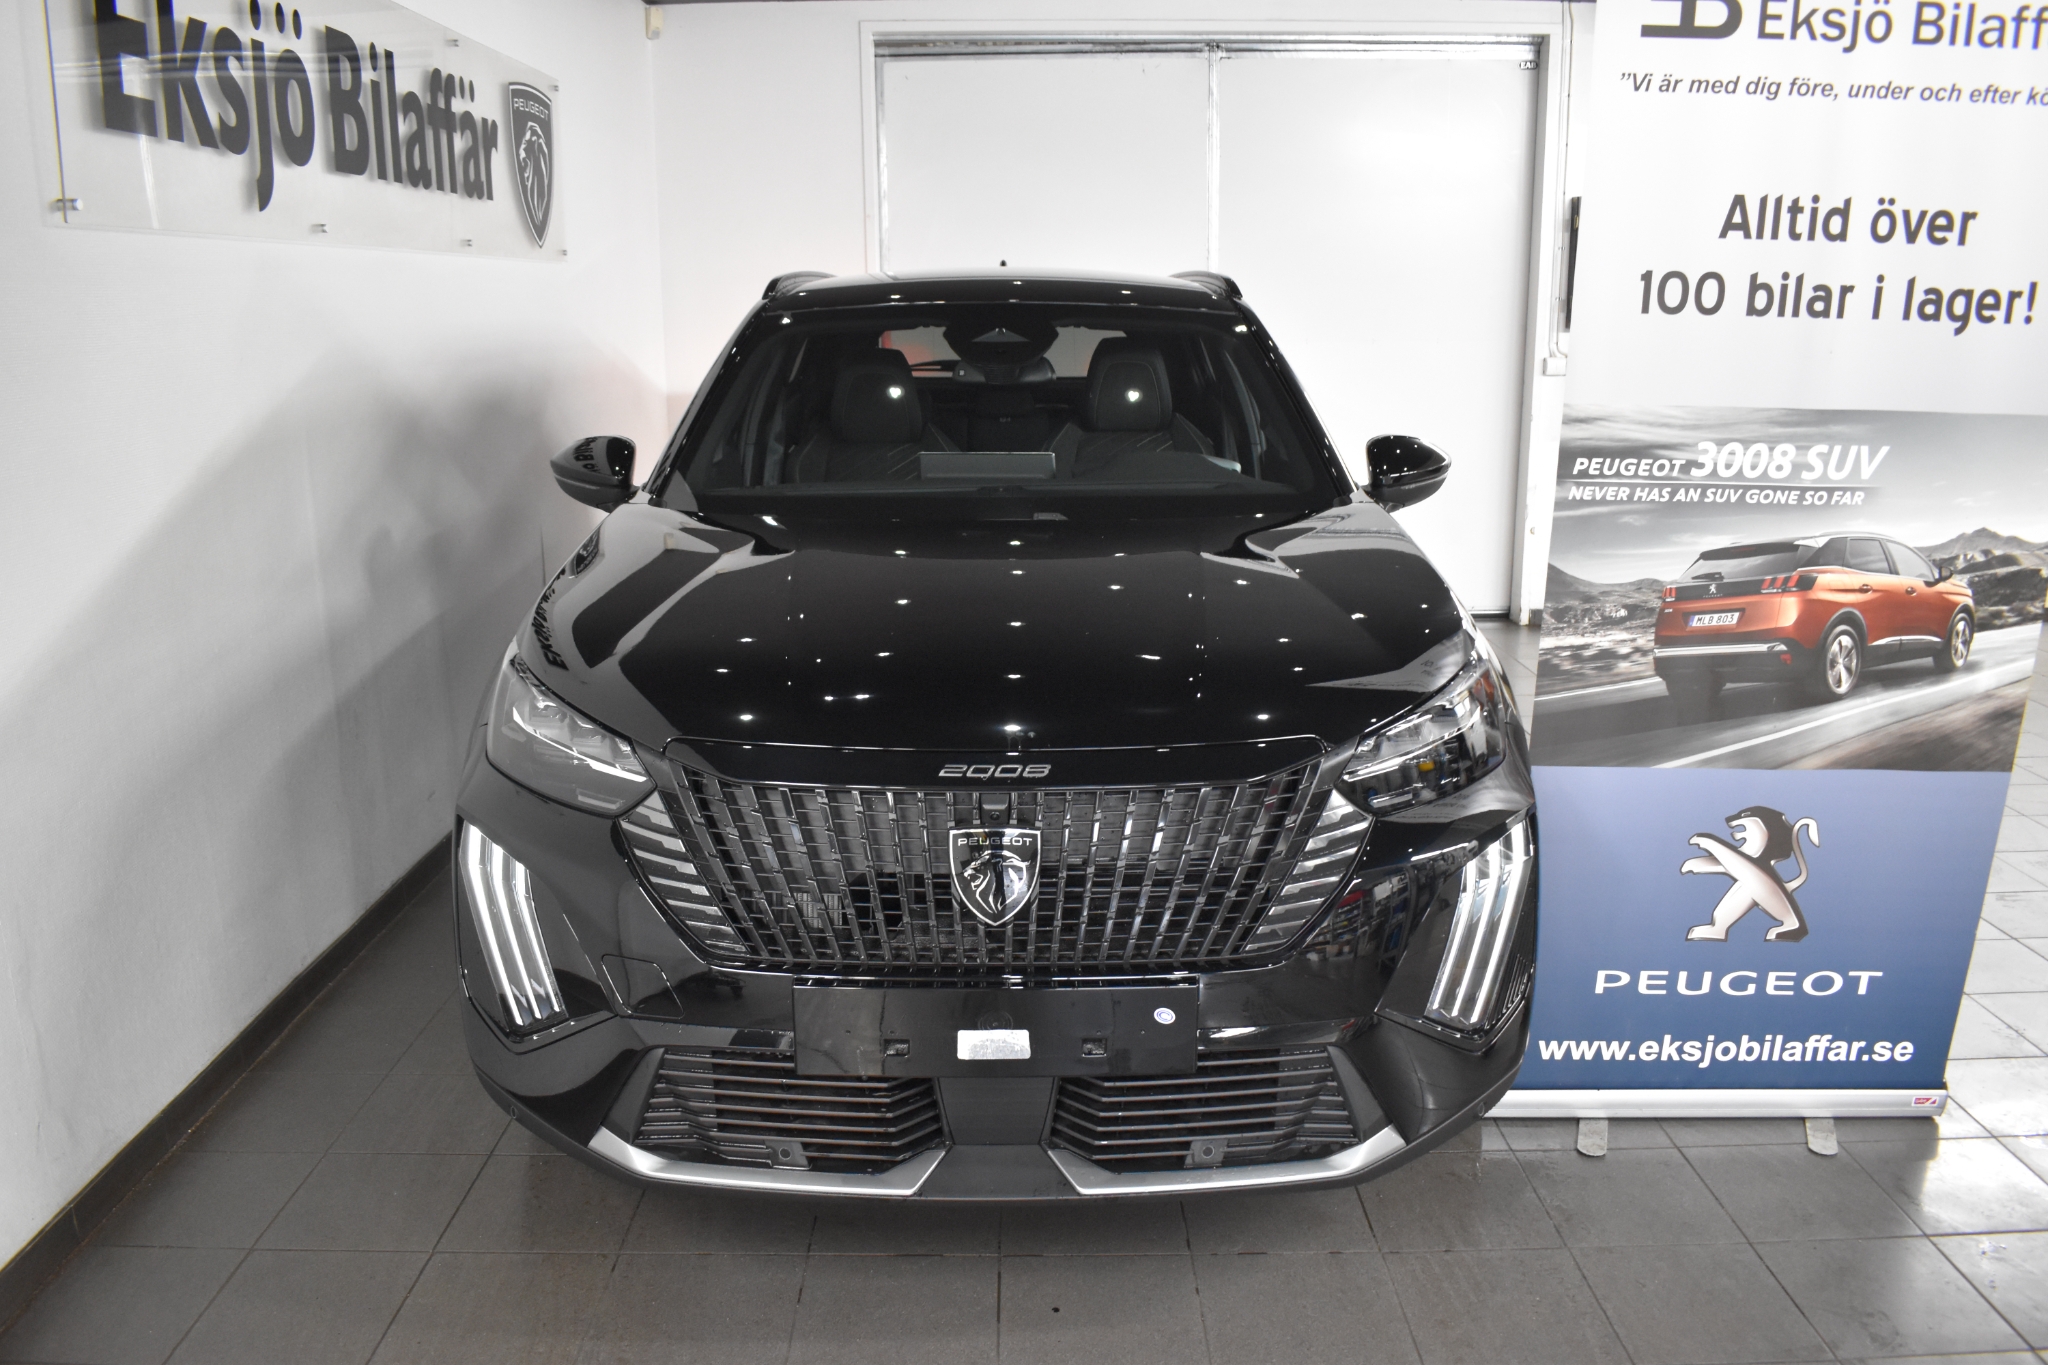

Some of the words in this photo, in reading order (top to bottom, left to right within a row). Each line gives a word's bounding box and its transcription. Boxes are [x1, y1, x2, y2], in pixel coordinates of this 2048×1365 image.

[1757, 0, 1892, 53] Eksjö
[1658, 74, 1683, 93] är
[1688, 76, 1740, 95] med
[1745, 76, 1781, 101] dig
[1788, 77, 1838, 101] före,
[1847, 80, 1915, 101] under
[1919, 83, 1962, 102] och
[1968, 84, 2022, 104] efter
[94, 0, 316, 211] Eksjö
[324, 25, 498, 201] Bilaffär
[513, 98, 549, 121] PEUGEOT
[1719, 194, 1852, 242] Alltid
[1870, 198, 1978, 246] över
[1640, 269, 1726, 316] 100
[1746, 272, 1855, 319] bilar
[1872, 274, 1885, 320] i
[1902, 276, 2039, 336] lager!
[1572, 458, 1686, 477] PEUGEOT
[1690, 441, 1796, 479] 3008
[1801, 445, 1890, 480] SUV
[1568, 486, 1631, 501] NEVER
[1633, 487, 1671, 502] HAS
[1673, 488, 1702, 503] AN
[1704, 489, 1743, 503] SUV
[1745, 489, 1800, 505] GONE
[1802, 491, 1828, 506] SO
[1831, 491, 1865, 506] FAR
[1696, 615, 1715, 625] MLB
[1716, 613, 1735, 623] 803
[938, 764, 1052, 778] 2008
[958, 837, 1033, 847] PEUGEOT
[1594, 969, 1884, 996] PEUGEOT
[1538, 1034, 1914, 1068] www.eksjobilaffar.se
